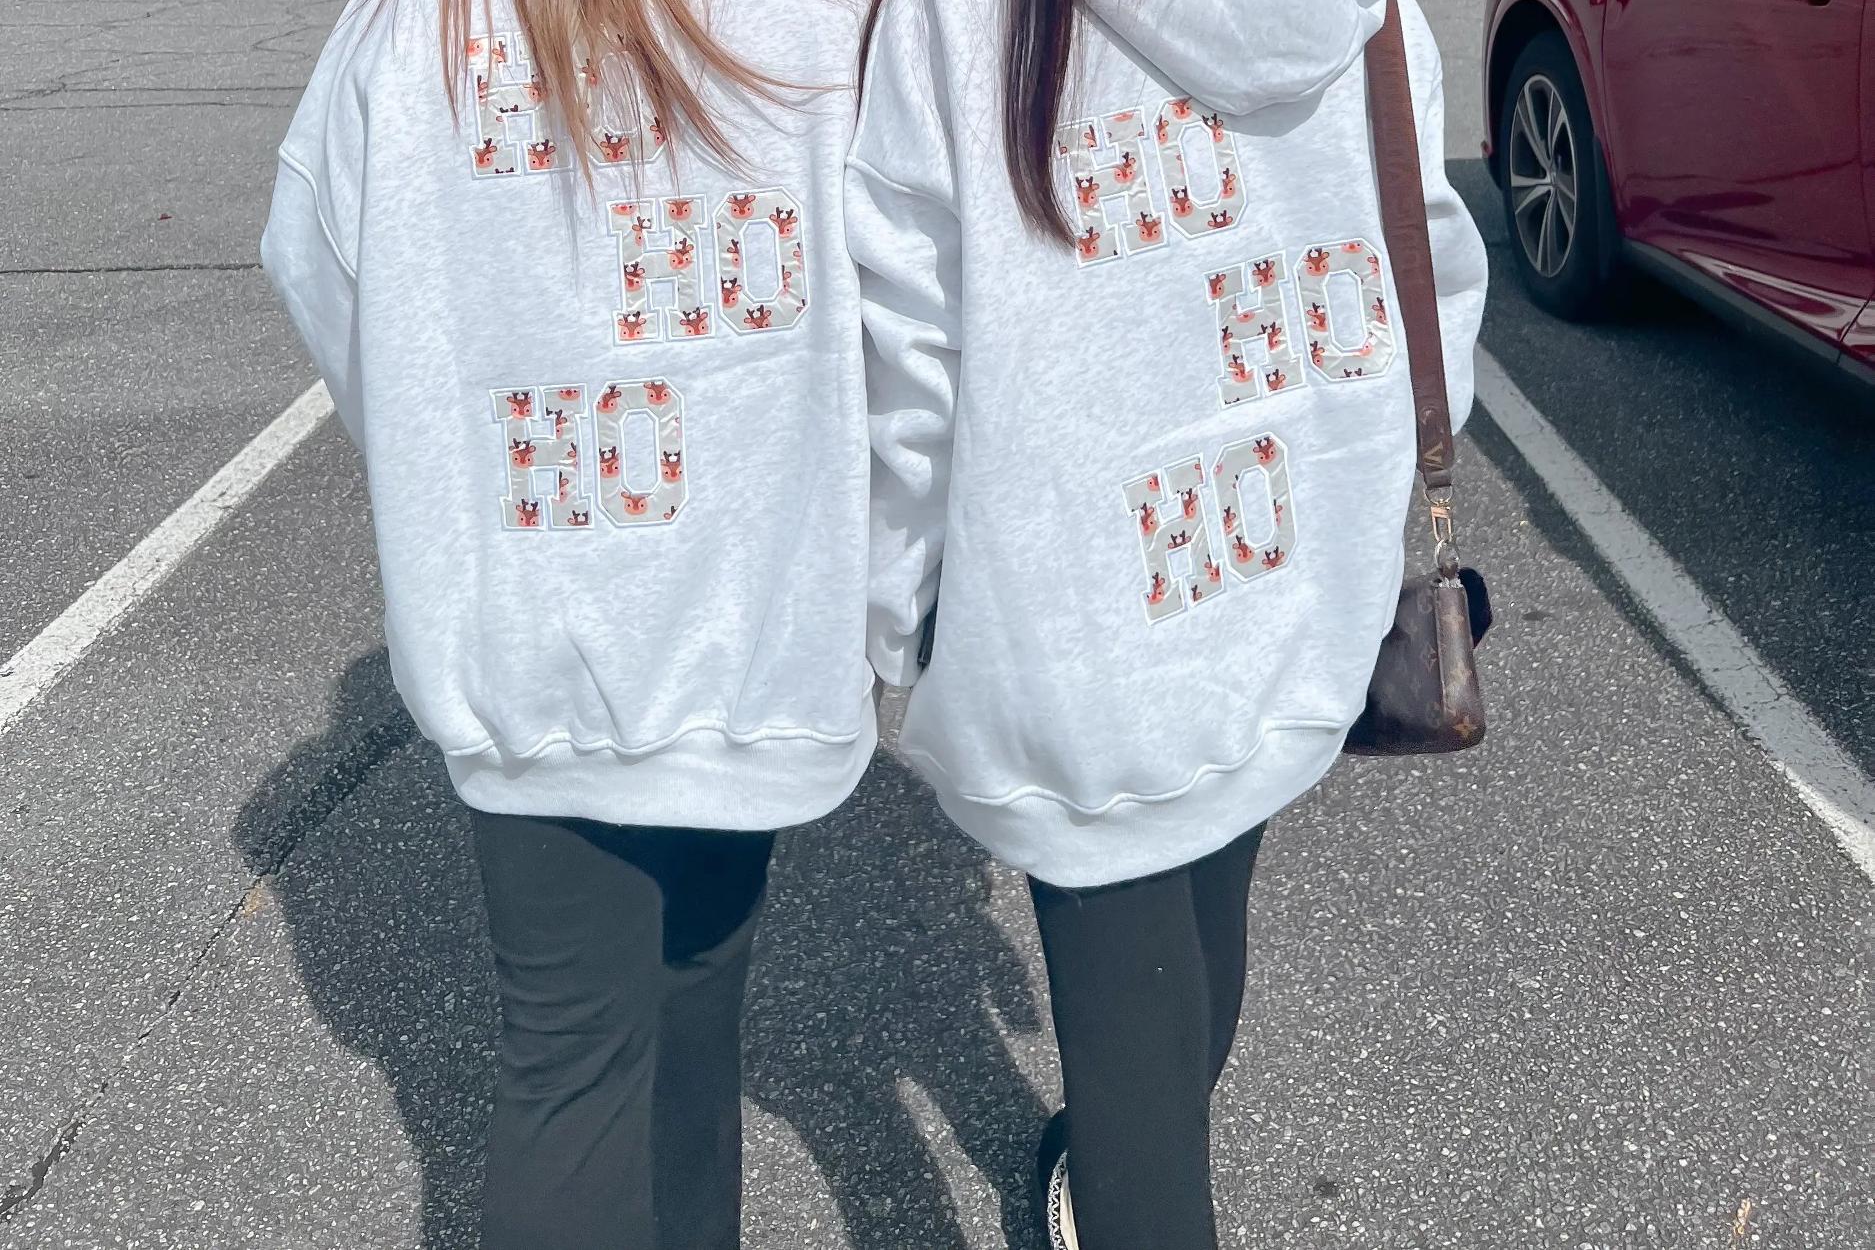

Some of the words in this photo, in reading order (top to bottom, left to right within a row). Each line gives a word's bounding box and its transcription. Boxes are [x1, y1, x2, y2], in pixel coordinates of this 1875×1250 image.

[606, 186, 810, 346] HO
[1053, 96, 1249, 269] HO
[1202, 238, 1399, 410] HO
[489, 376, 690, 531] HO
[1121, 431, 1298, 627] HO
